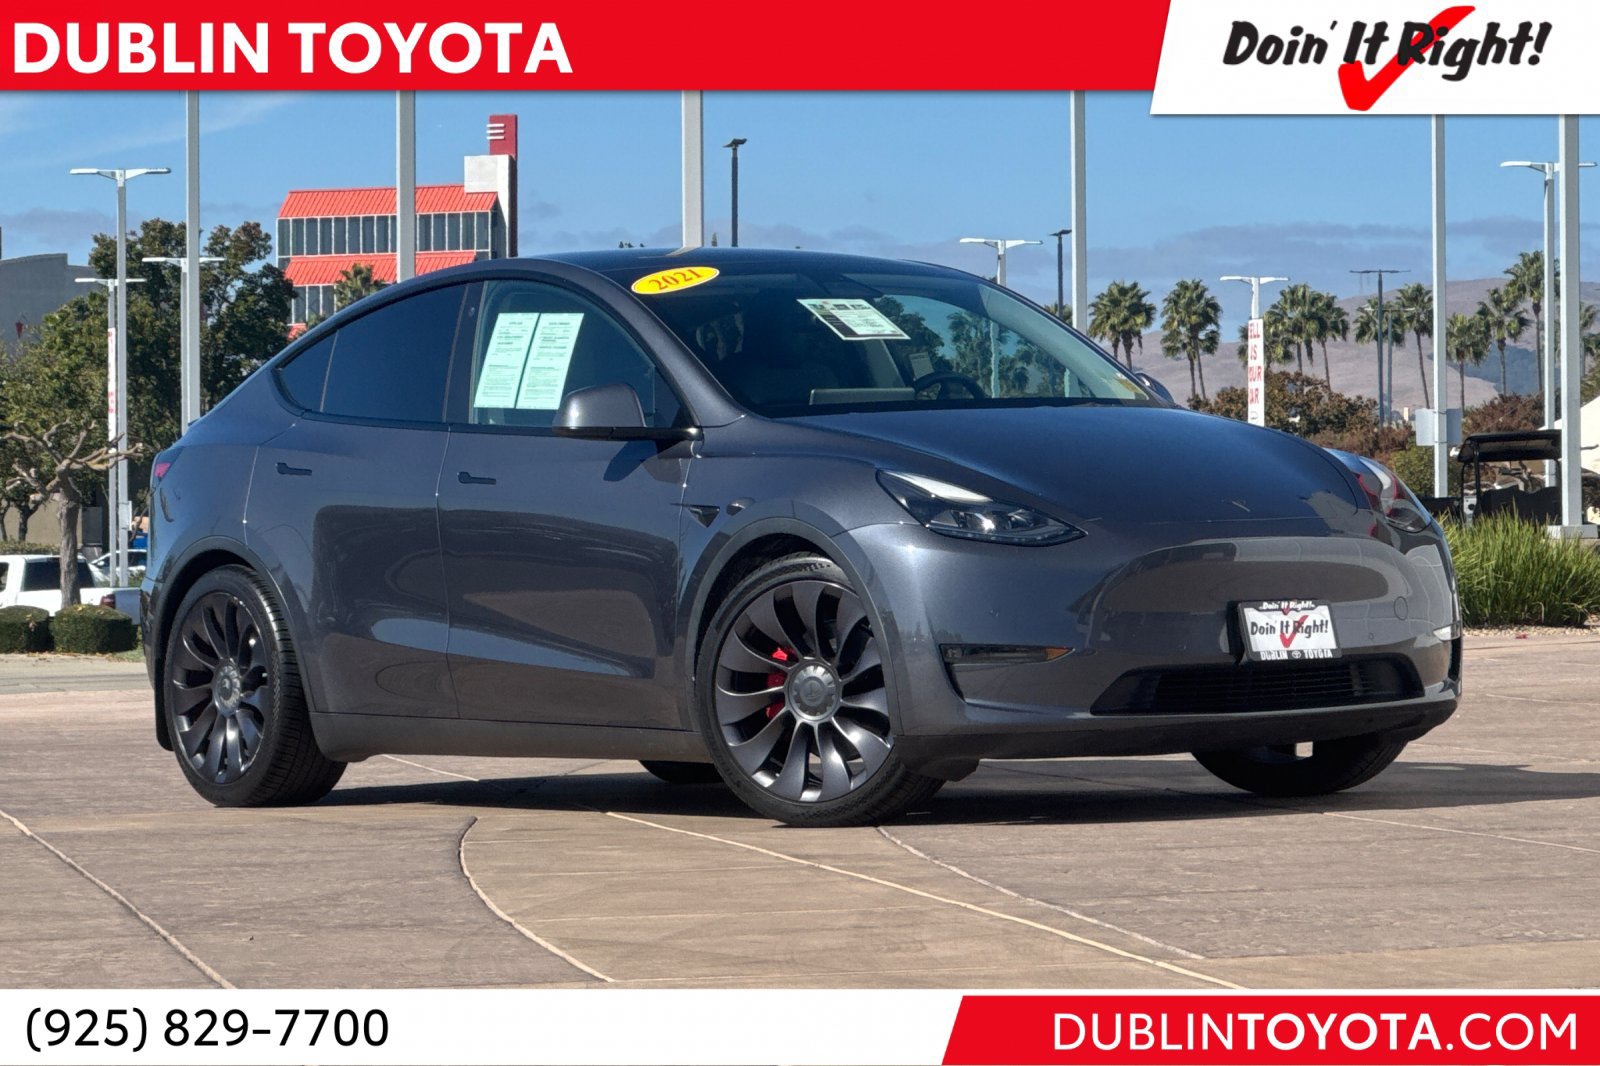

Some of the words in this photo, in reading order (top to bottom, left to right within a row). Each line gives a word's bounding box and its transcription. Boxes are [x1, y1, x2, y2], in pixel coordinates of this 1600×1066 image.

[648, 269, 704, 291] 2021
[1248, 322, 1261, 339] ELL
[1279, 620, 1291, 635] It
[1292, 619, 1329, 639] Right!
[1259, 649, 1289, 661] DUBLIN
[1303, 648, 1334, 660] TOYOTA
